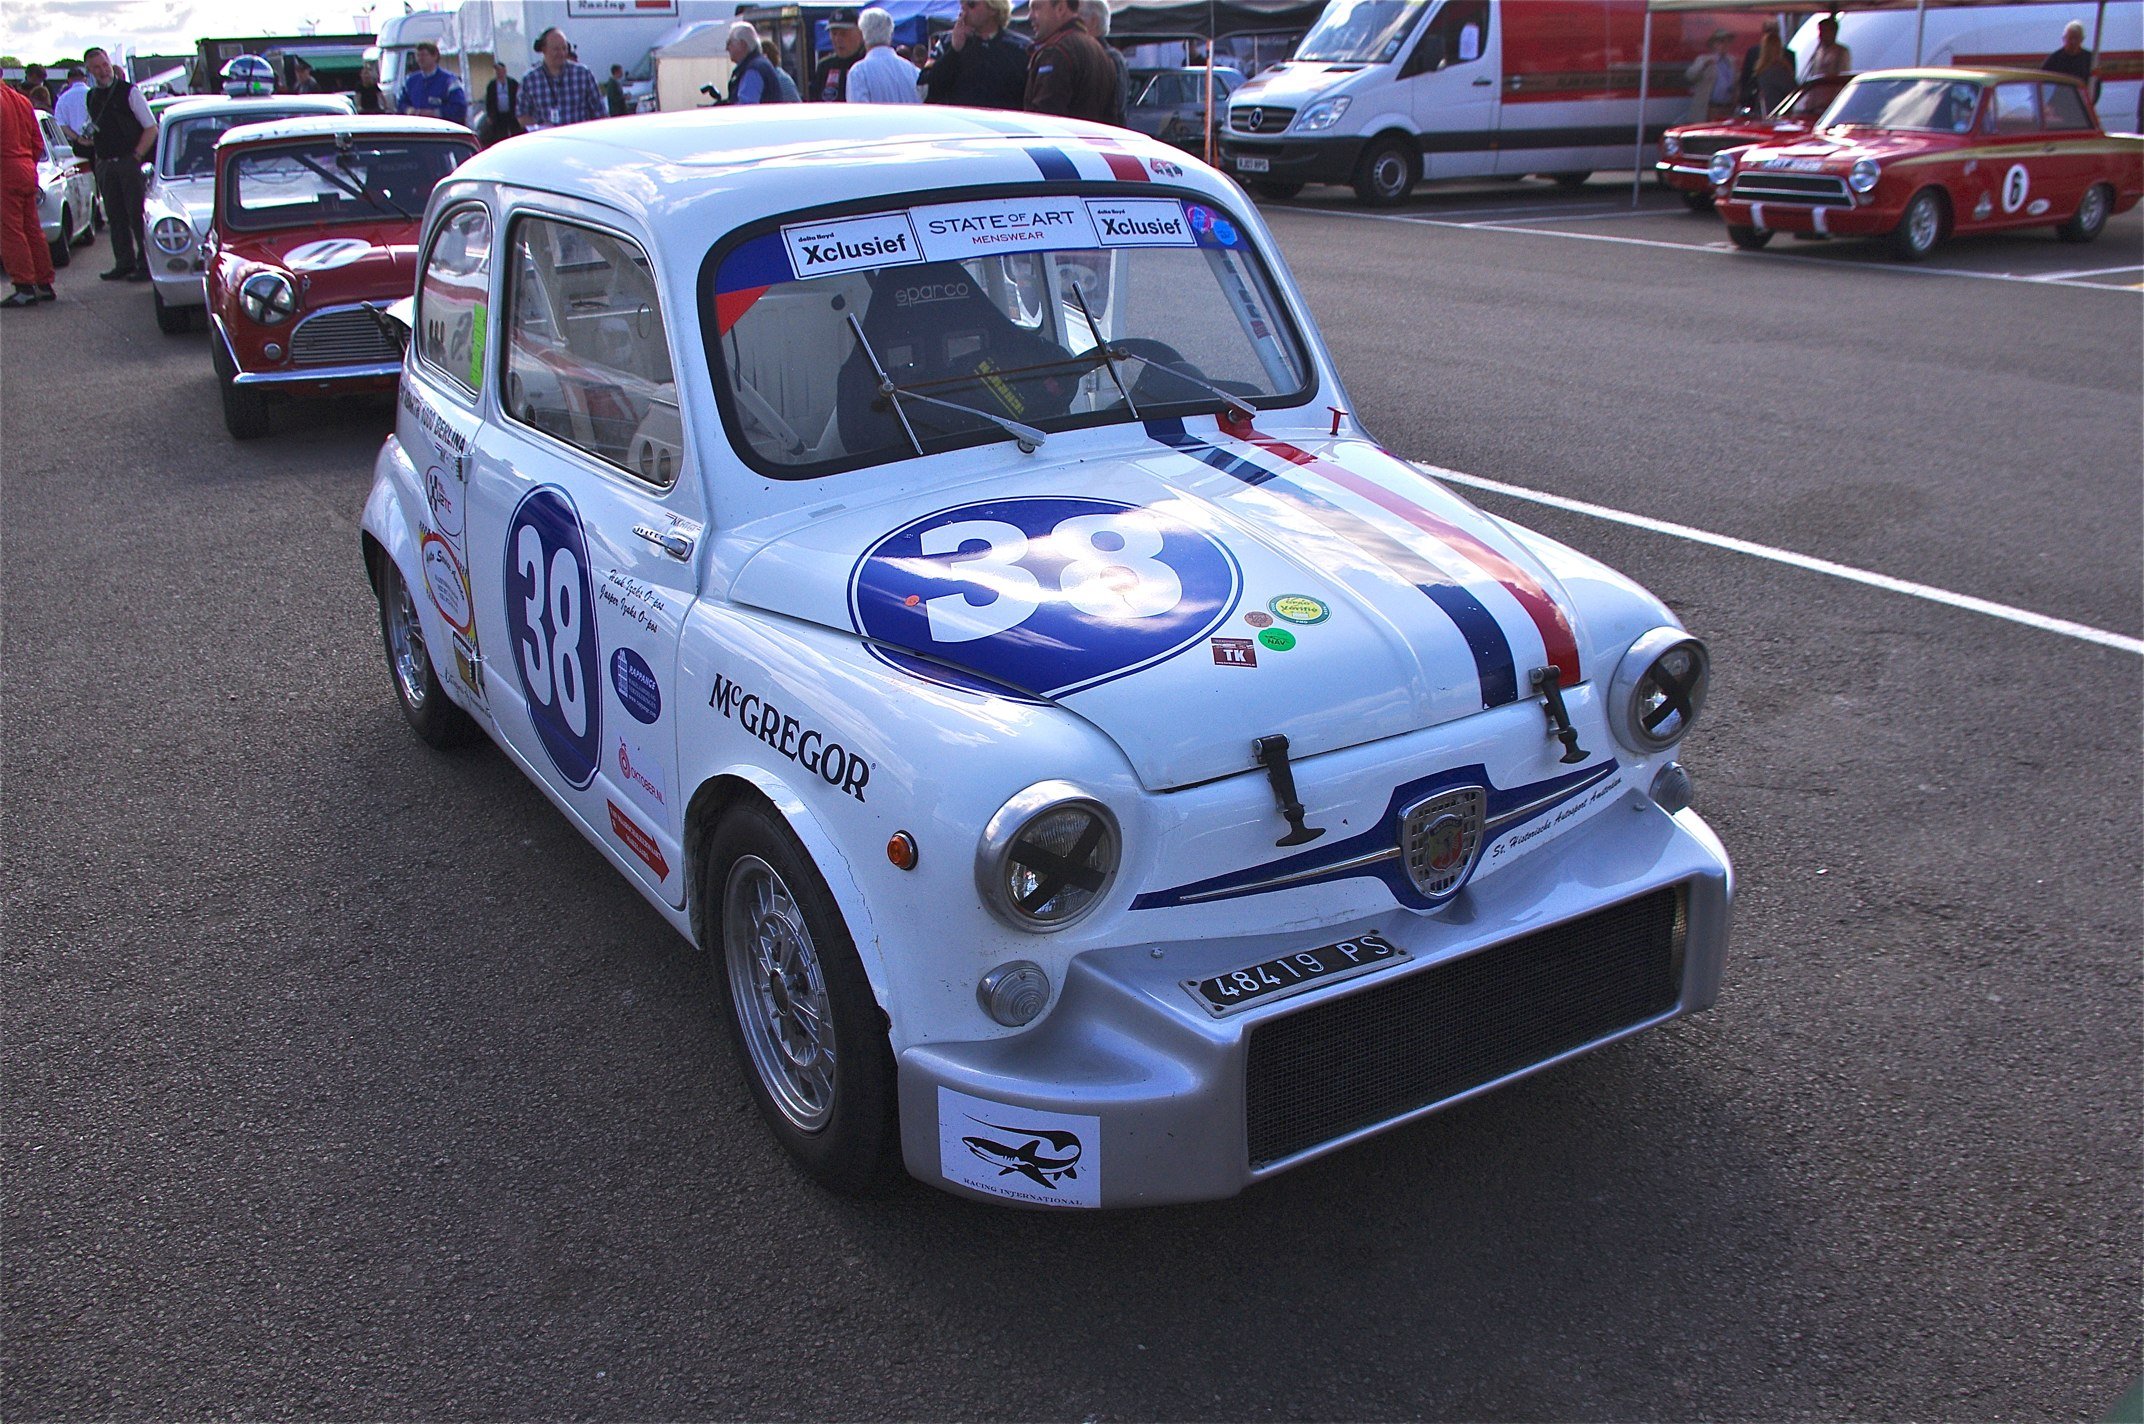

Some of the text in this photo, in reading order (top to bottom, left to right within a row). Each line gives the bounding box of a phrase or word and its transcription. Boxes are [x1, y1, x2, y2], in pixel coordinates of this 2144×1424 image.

[2009, 169, 2022, 207] 6
[816, 232, 835, 240] lloyd
[928, 211, 1075, 235] STATE OF ART
[1101, 217, 1183, 236] Xclusief
[802, 233, 907, 266] Xclusief
[971, 231, 1045, 245] MENSWEAR
[895, 282, 969, 308] sparco
[433, 415, 467, 455] BERLINA
[919, 513, 1184, 644] 38
[599, 584, 619, 607] Jasper
[517, 524, 587, 739] 38
[1223, 649, 1247, 663] TK
[628, 665, 656, 691] RAPPANGE
[1509, 820, 1552, 848] Historische
[1553, 798, 1588, 826] Autosport
[1214, 935, 1390, 998] 48419 PS
[963, 1177, 1083, 1206] RACING INTERNATIONAL
